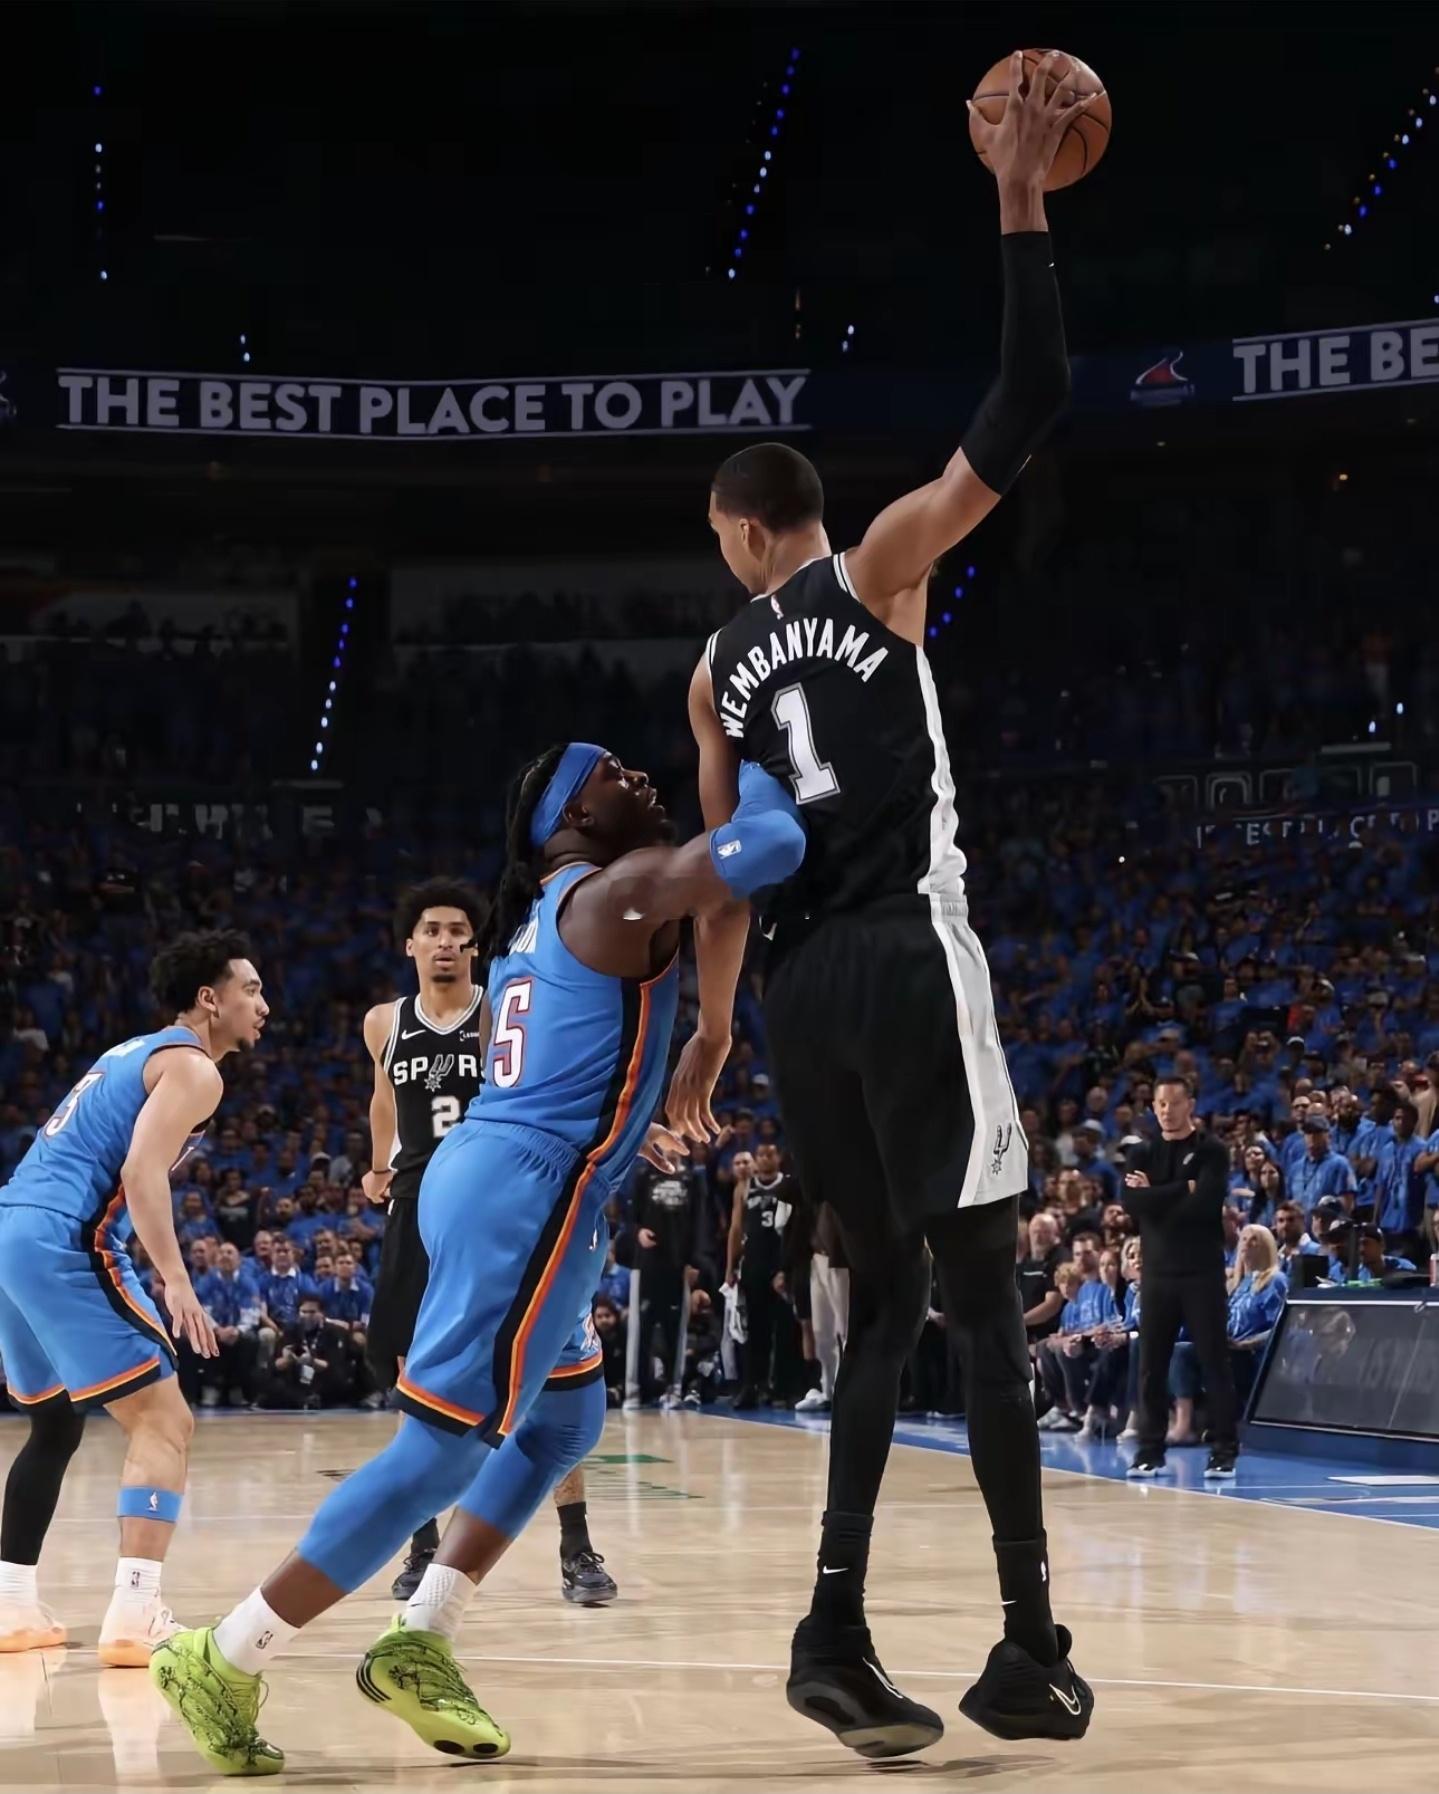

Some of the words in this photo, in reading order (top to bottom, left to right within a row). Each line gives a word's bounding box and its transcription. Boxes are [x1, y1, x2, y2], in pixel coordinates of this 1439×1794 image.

[58, 375, 180, 427] THE
[200, 381, 342, 432] BEST
[359, 384, 546, 435] PLACE
[561, 381, 642, 430] TO
[661, 376, 806, 427] PLAY
[1233, 336, 1351, 394] THE
[720, 618, 889, 738] WEMBANYAMA
[771, 682, 841, 805] 1
[393, 1053, 485, 1089] SPUR
[492, 975, 533, 1088] 5
